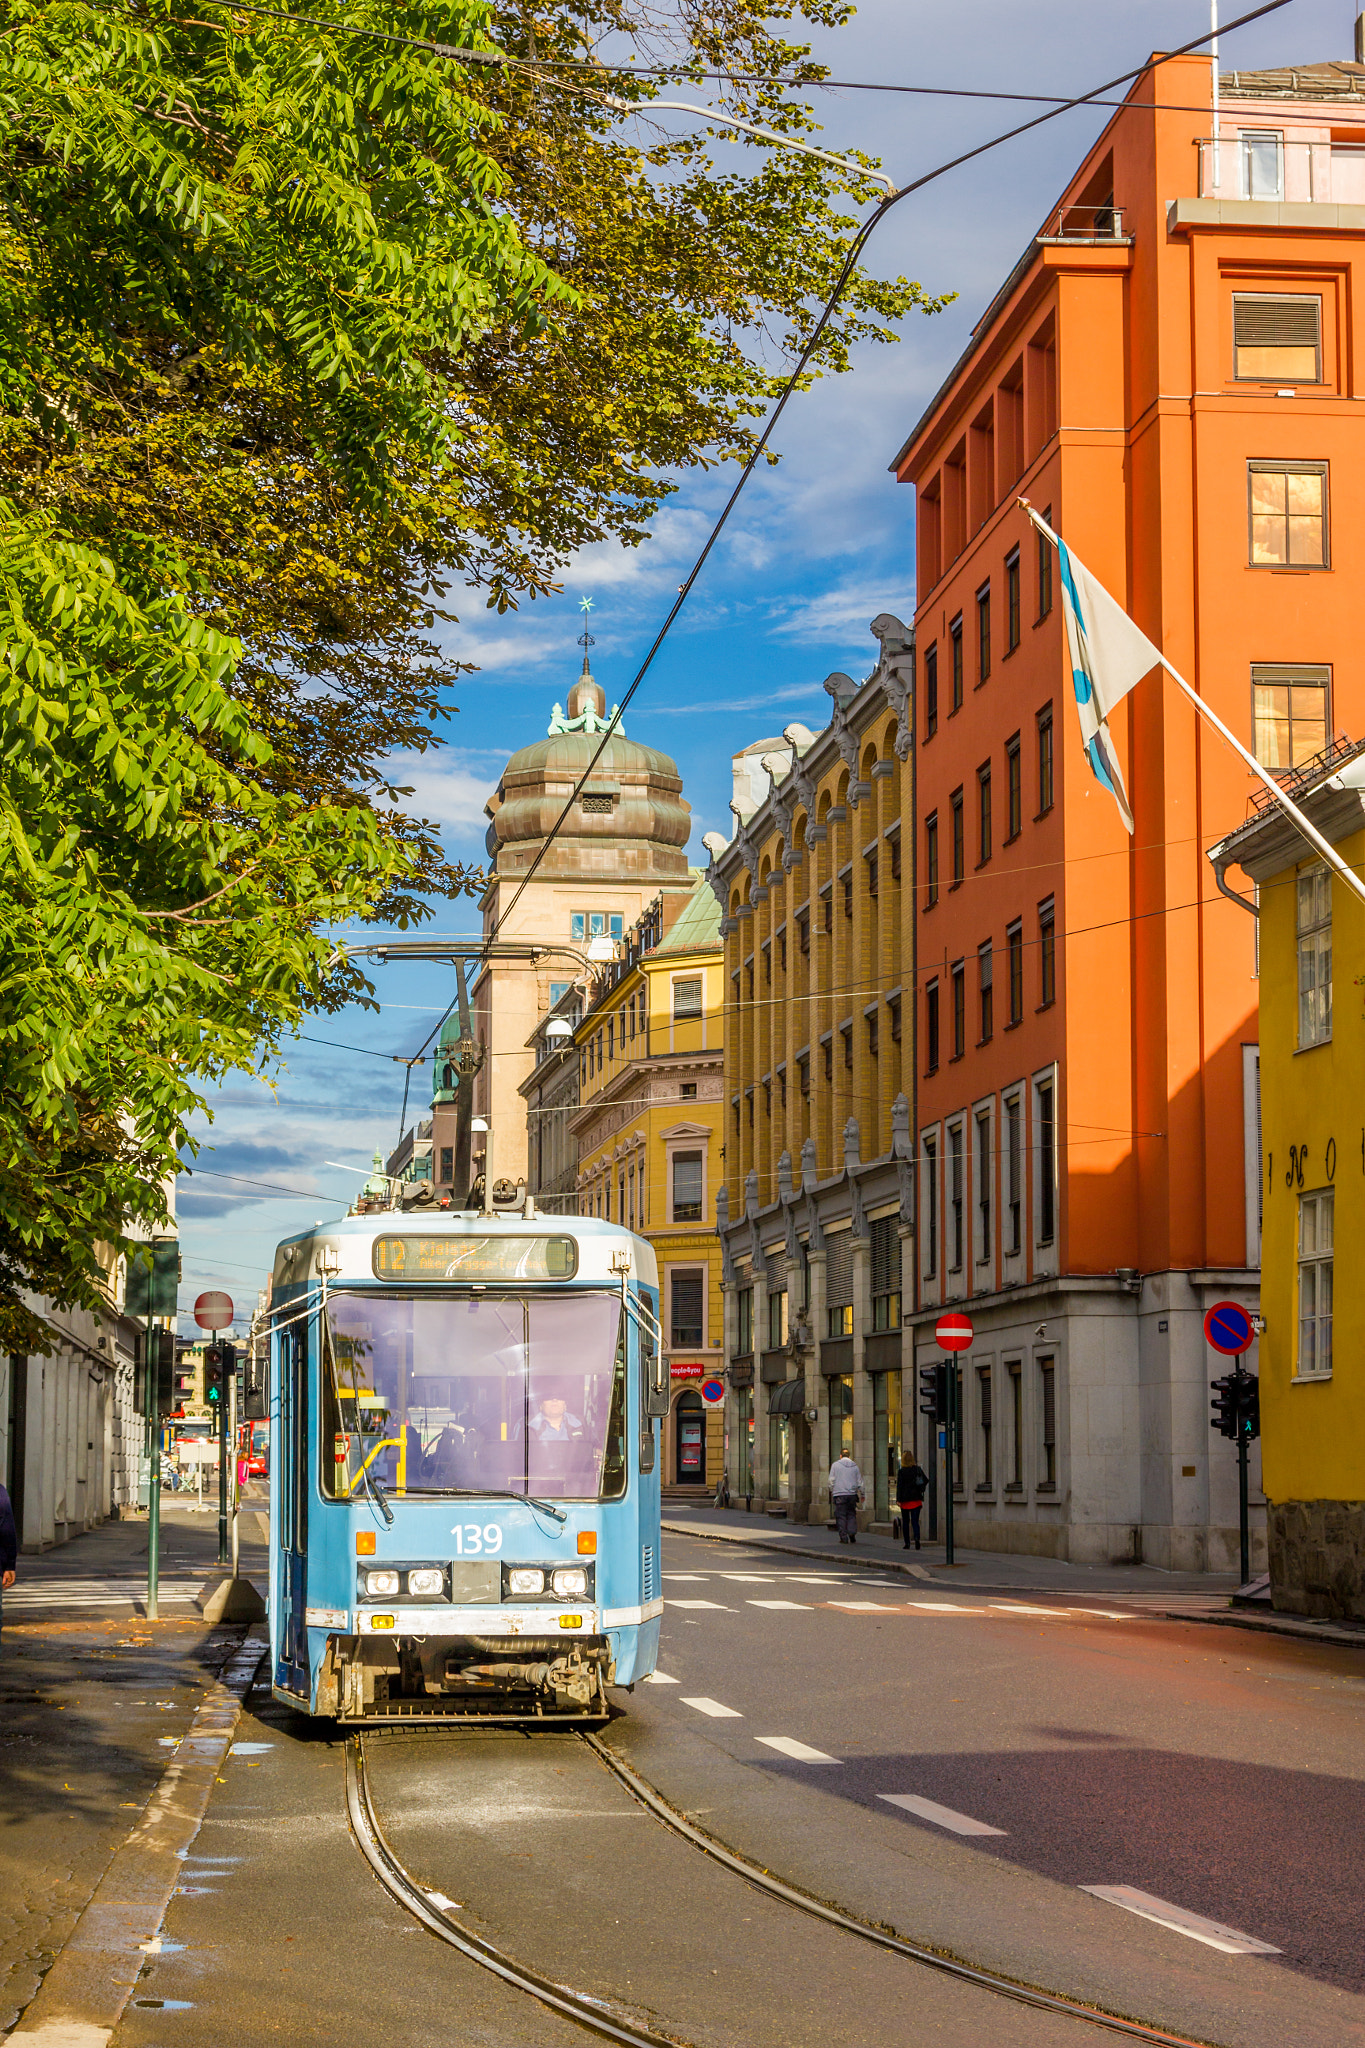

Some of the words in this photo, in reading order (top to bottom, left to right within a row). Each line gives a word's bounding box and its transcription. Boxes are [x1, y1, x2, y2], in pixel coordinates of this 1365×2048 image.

[378, 1241, 405, 1270] 12
[419, 1257, 448, 1269] Aker
[671, 1366, 700, 1376] eople4you
[450, 1523, 503, 1555] 139
